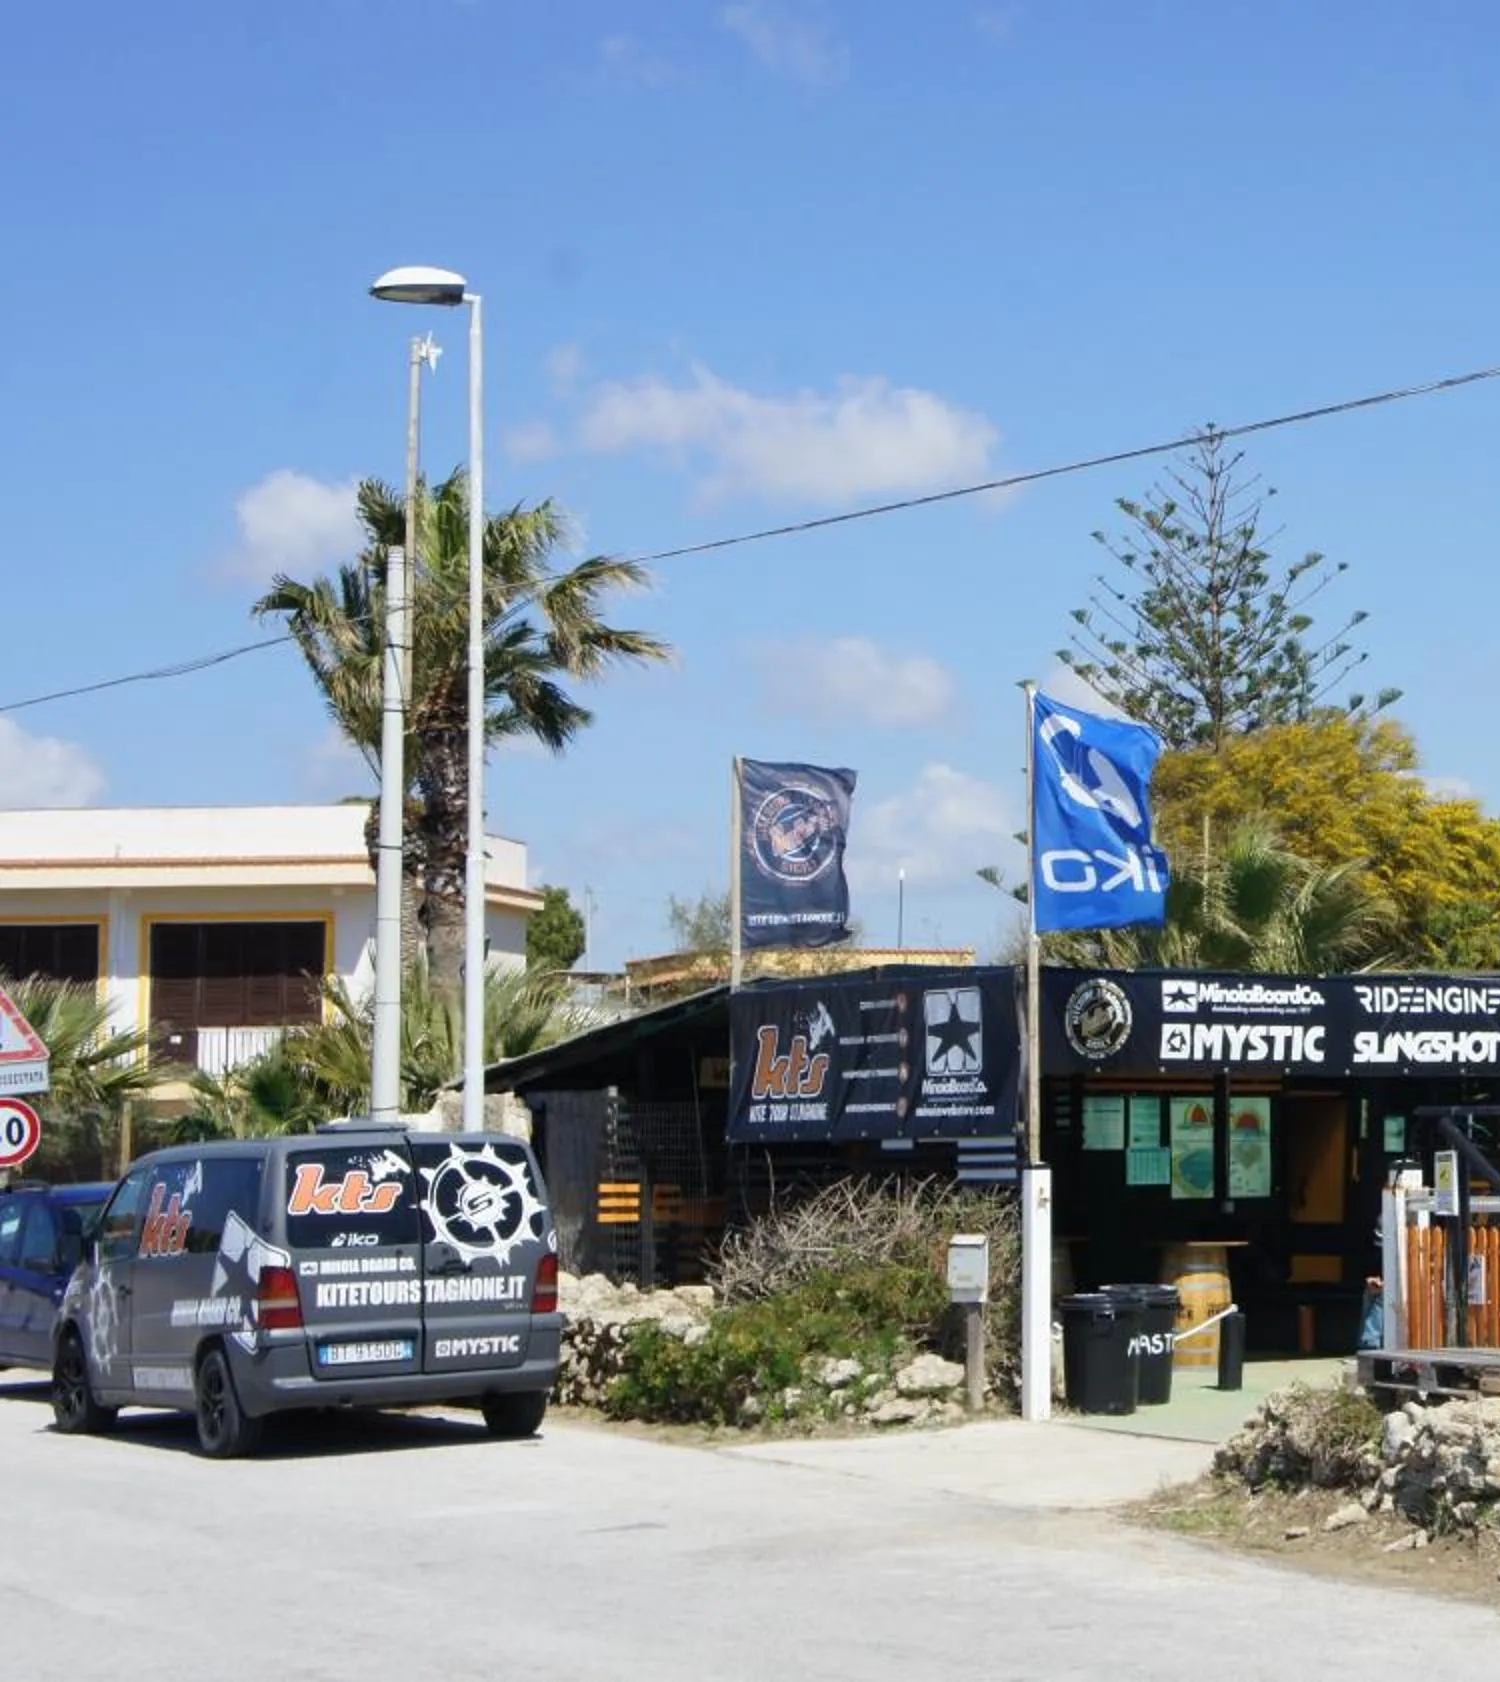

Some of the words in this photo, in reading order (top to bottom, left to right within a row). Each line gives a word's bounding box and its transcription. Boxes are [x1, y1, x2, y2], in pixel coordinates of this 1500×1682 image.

[1199, 983, 1325, 1005] MinoiaBoardCo.
[752, 1025, 830, 1099] kts
[1192, 1023, 1325, 1062] MYSTIC
[0, 1117, 25, 1147] 0
[288, 1163, 403, 1215] kts
[139, 1183, 193, 1258] kts
[452, 1335, 520, 1356] MYSTIC
